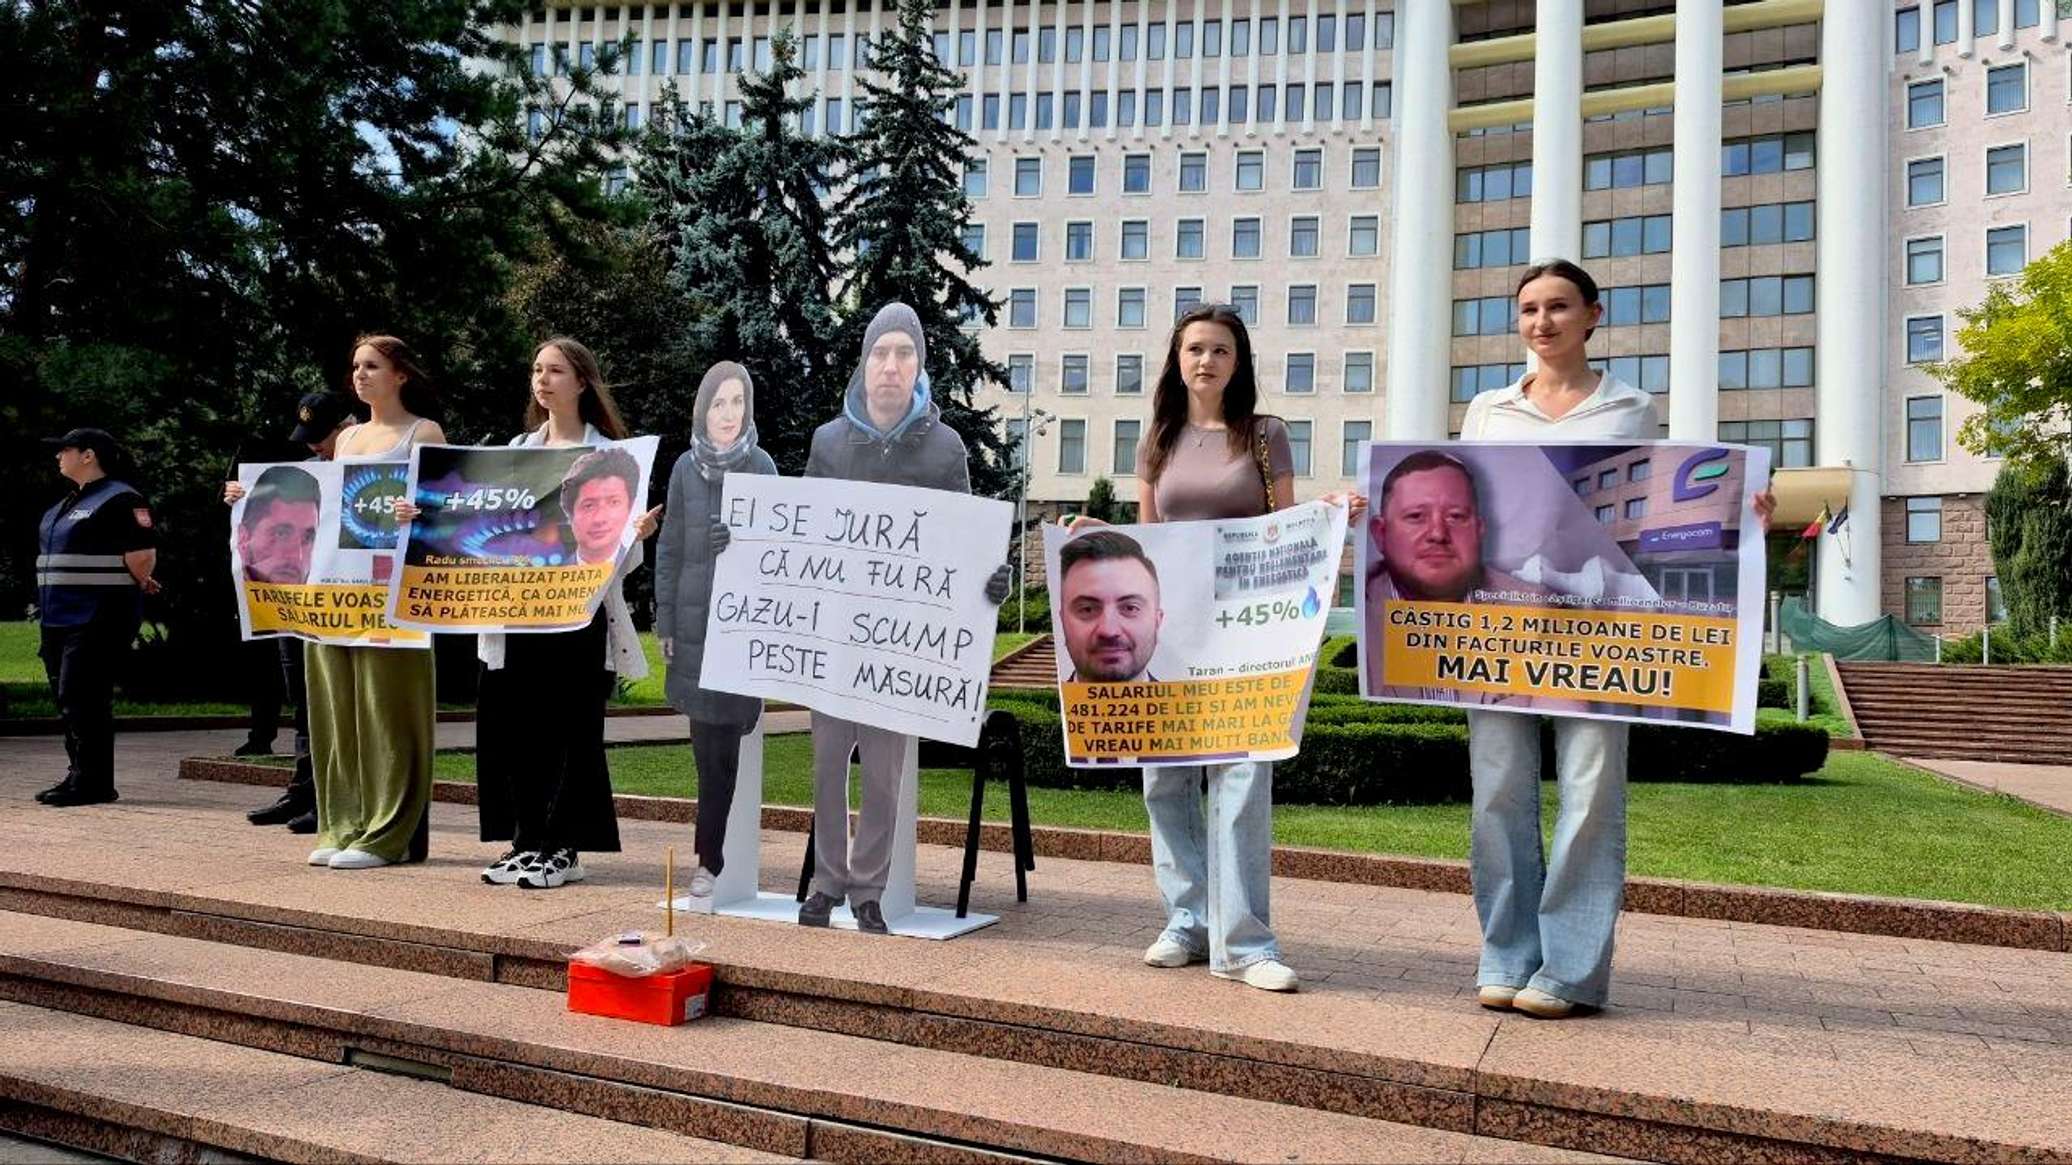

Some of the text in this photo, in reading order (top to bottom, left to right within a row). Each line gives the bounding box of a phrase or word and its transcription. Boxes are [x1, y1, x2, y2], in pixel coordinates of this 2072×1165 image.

[446, 488, 535, 510] +45%
[729, 498, 928, 553] EI SE JURĂ
[1662, 528, 1713, 540] Energocom
[425, 554, 456, 565] Radu
[423, 572, 449, 585] AM
[455, 571, 556, 585] LIBERALIZAT
[759, 549, 957, 599] CĂ NU FURĂ
[250, 588, 324, 607] TARIFELE
[408, 586, 514, 602] ENERGETICĂ,
[522, 589, 541, 601] CA
[277, 607, 354, 629] SALARIUL
[409, 601, 433, 617] SĂ
[440, 600, 528, 619] PLĂTEASCĂ
[533, 605, 562, 618] MAI
[1215, 600, 1300, 628] +45%
[850, 613, 974, 660] SCUMP
[1480, 616, 1514, 632] 1,2
[1523, 618, 1642, 640] MILIOANE
[1652, 624, 1682, 642] DE
[1692, 627, 1731, 646] LEI
[1406, 632, 1710, 668] DIN FACTURILE VOASTRE.
[749, 639, 982, 722] PESTE MĂSURĂ!
[1088, 674, 1293, 699] SALARIUL MEU ESTE DE
[1437, 655, 1672, 697] MAI VREAU!
[1146, 702, 1168, 716] DE
[1175, 701, 1203, 715] LEI
[1233, 696, 1257, 711] AM
[1068, 720, 1085, 734] DE
[1091, 720, 1155, 735] TARIFE
[1162, 719, 1196, 733] MAI
[1203, 715, 1246, 731] MARI
[1252, 713, 1273, 728] LA
[1084, 739, 1142, 753] VREAU
[1150, 737, 1184, 752] MAI
